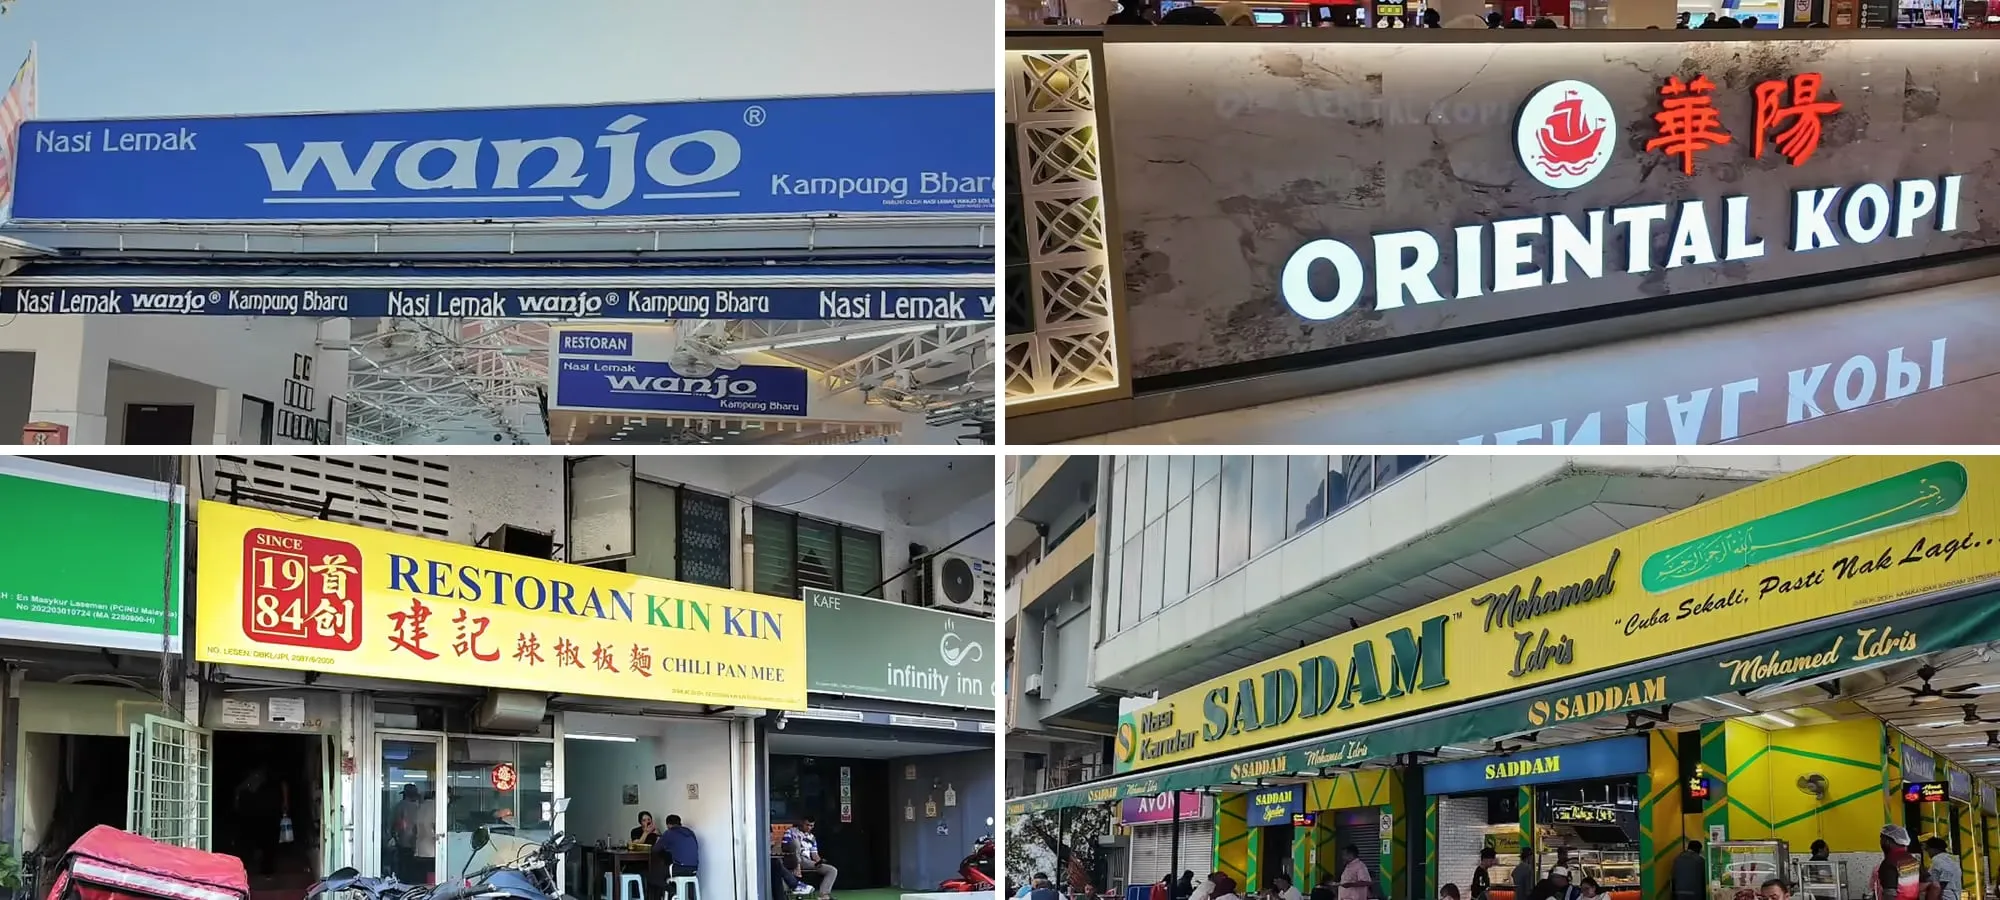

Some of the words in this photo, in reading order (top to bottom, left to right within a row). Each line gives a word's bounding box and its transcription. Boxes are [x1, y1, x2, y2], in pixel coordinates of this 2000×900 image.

[1646, 72, 1844, 176] 華陽
[35, 130, 91, 154] Nasi
[103, 128, 197, 152] Lemak
[245, 114, 741, 210] wanjo
[771, 174, 908, 199] Kampung
[1281, 195, 1764, 320] ORIENTAL
[1794, 174, 1961, 251] KOPI
[17, 289, 54, 314] Nasi
[60, 289, 121, 314] Lemak
[131, 291, 205, 312] wanjo
[228, 291, 298, 314] Kampung
[303, 290, 348, 312] Bharu
[388, 291, 430, 316] Nasi
[437, 291, 506, 317] Lemak
[518, 294, 602, 317] wanjo
[628, 291, 710, 316] Kampung
[715, 291, 769, 313] Bharu
[819, 290, 870, 318] Nasi
[880, 291, 966, 320] Lemak
[564, 336, 627, 350] RESTORAN
[563, 361, 590, 371] Nasi
[594, 362, 636, 373] Lemak
[604, 375, 757, 399] wanjo
[720, 399, 766, 411] Kampung
[769, 402, 800, 411] Bharu
[256, 533, 304, 551] SINCE
[259, 555, 304, 592] 19
[1758, 568, 1826, 599] Pasti
[1832, 547, 1892, 580] Nak
[16, 594, 29, 602] En
[387, 553, 634, 622] RESTORAN
[646, 594, 711, 633] KIN
[723, 605, 784, 642] KIN
[813, 593, 841, 611] KAFE
[1471, 549, 1621, 633] Mohamed
[16, 602, 29, 611] No
[256, 594, 304, 631] 84
[1509, 630, 1574, 677] Idris
[662, 656, 711, 677] CHILI
[716, 661, 748, 680] PAN
[751, 666, 785, 684] MEE
[887, 662, 949, 697] infinity
[957, 672, 983, 696] inn
[1203, 615, 1451, 742] SADDAM
[1554, 676, 1667, 722] SADDAM
[1719, 636, 1843, 686] Mohamed
[1853, 627, 1918, 663] Idris
[1140, 703, 1174, 734] Nasi
[1140, 729, 1198, 760] Kandar
[1241, 756, 1286, 778] SADDAM
[1304, 744, 1345, 766] Mohamed
[1347, 741, 1368, 759] Idris
[1485, 756, 1560, 780] SADDAM
[1255, 790, 1292, 806] SADDAM
